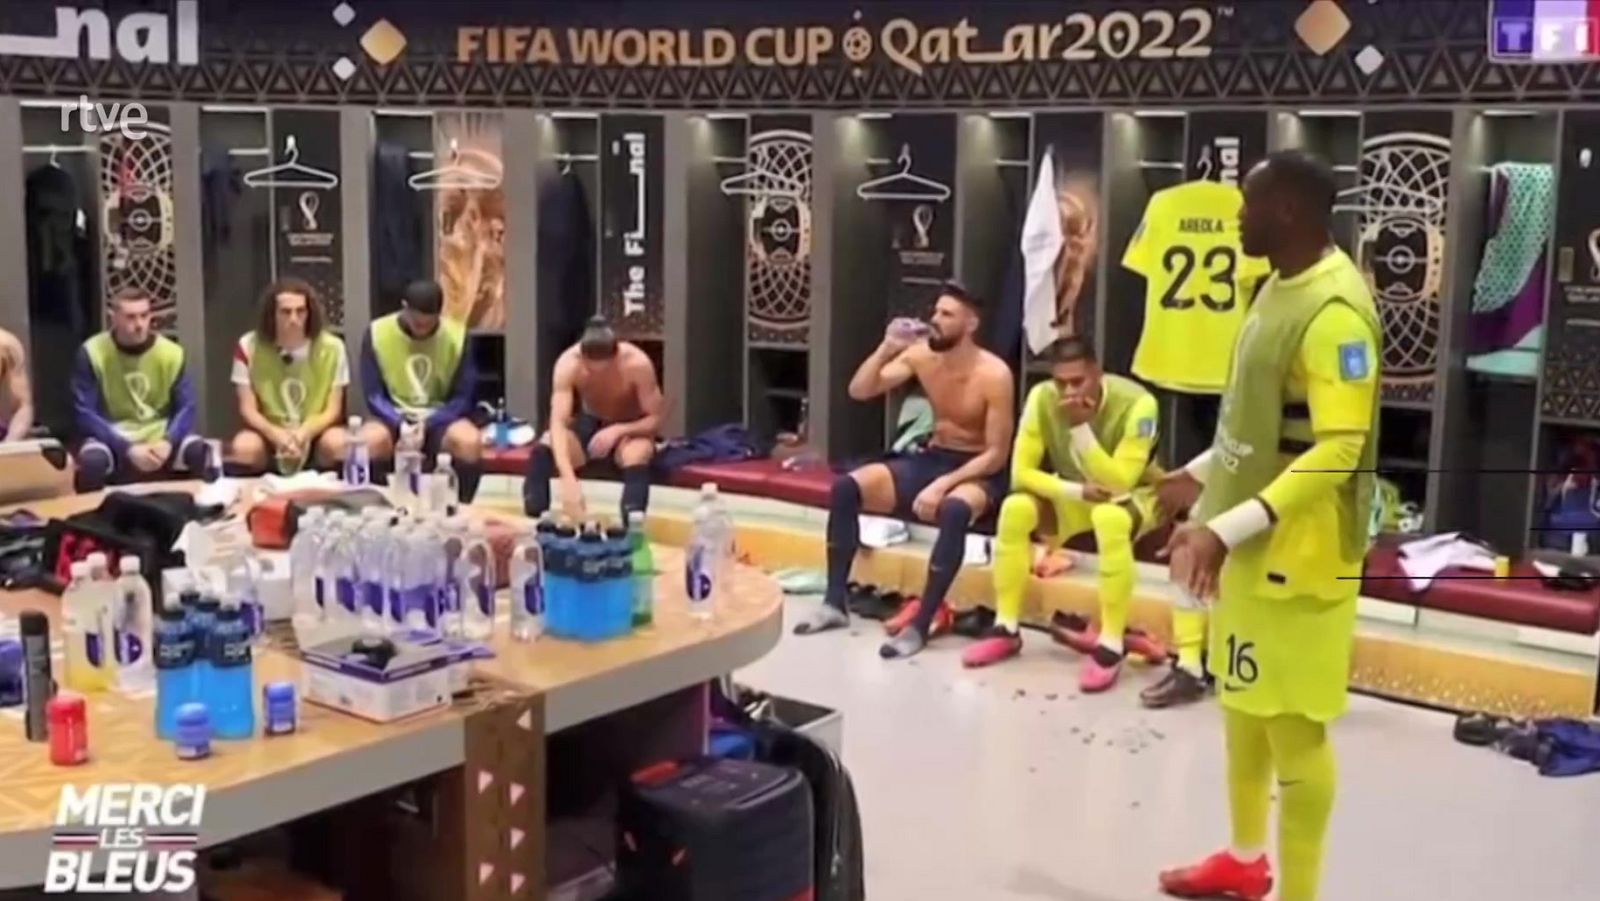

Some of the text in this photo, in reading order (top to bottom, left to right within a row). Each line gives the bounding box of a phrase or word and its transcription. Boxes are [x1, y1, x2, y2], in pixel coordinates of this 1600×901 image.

[457, 26, 557, 63] FIFA
[567, 28, 736, 67] WORLD
[745, 27, 833, 66] CUP
[1178, 217, 1225, 234] AREOLA
[623, 266, 646, 317] The
[1160, 245, 1236, 312] 23
[1225, 633, 1259, 685] 16
